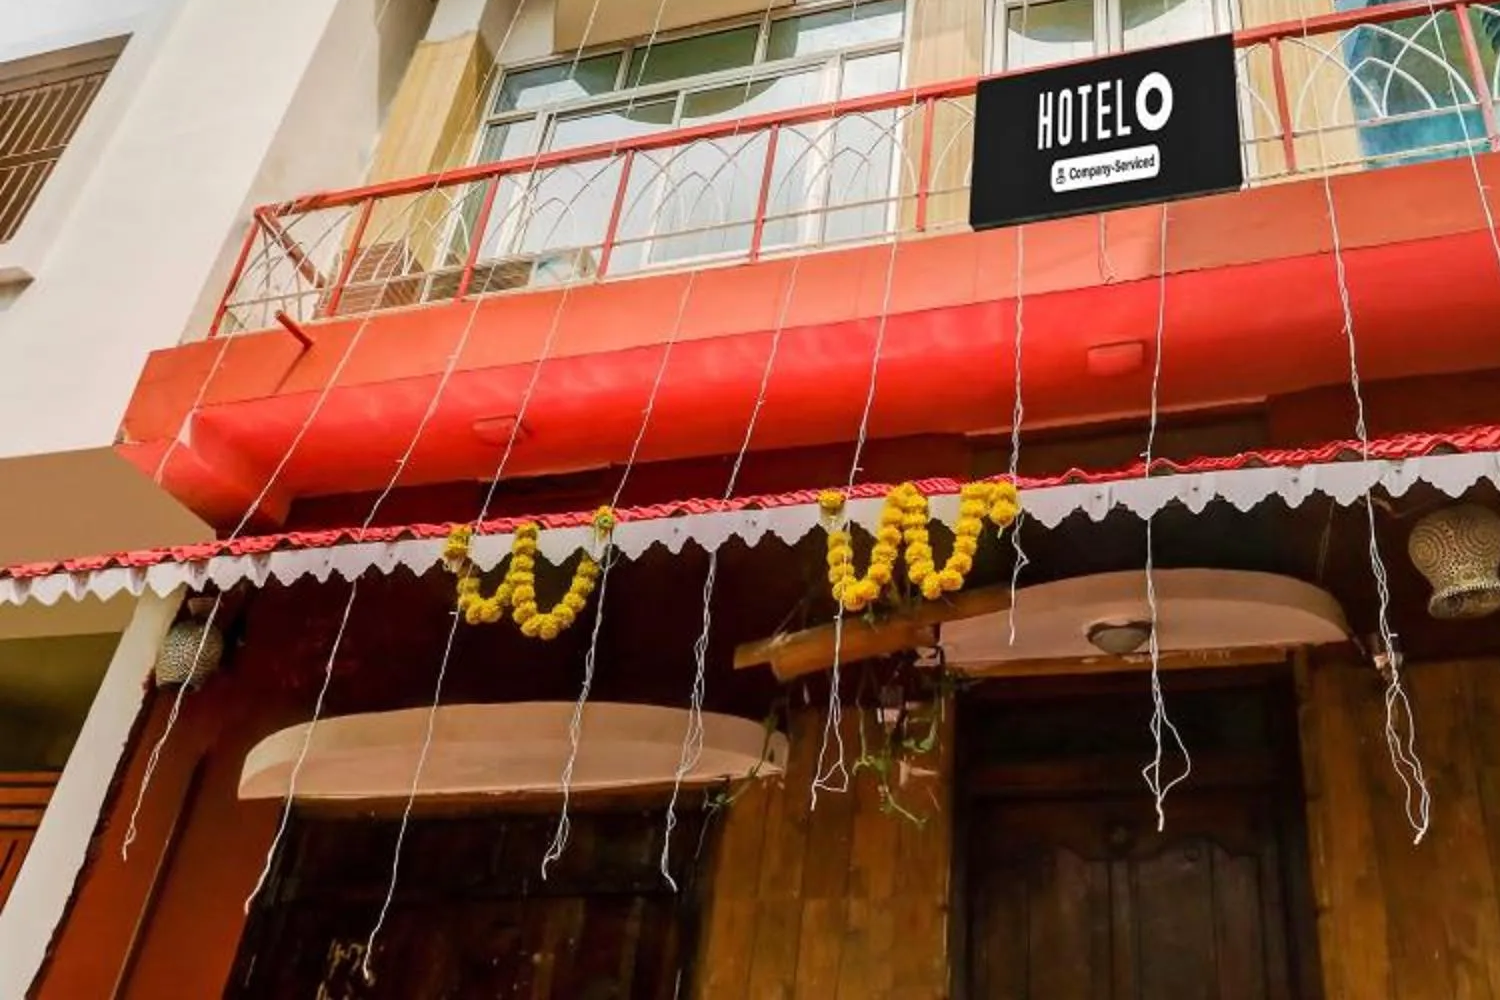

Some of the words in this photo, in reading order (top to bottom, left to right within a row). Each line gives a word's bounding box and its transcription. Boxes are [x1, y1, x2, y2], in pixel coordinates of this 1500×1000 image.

[1037, 78, 1132, 150] HOTEL
[1135, 71, 1173, 131] O
[1069, 153, 1155, 180] Company-Serviced
